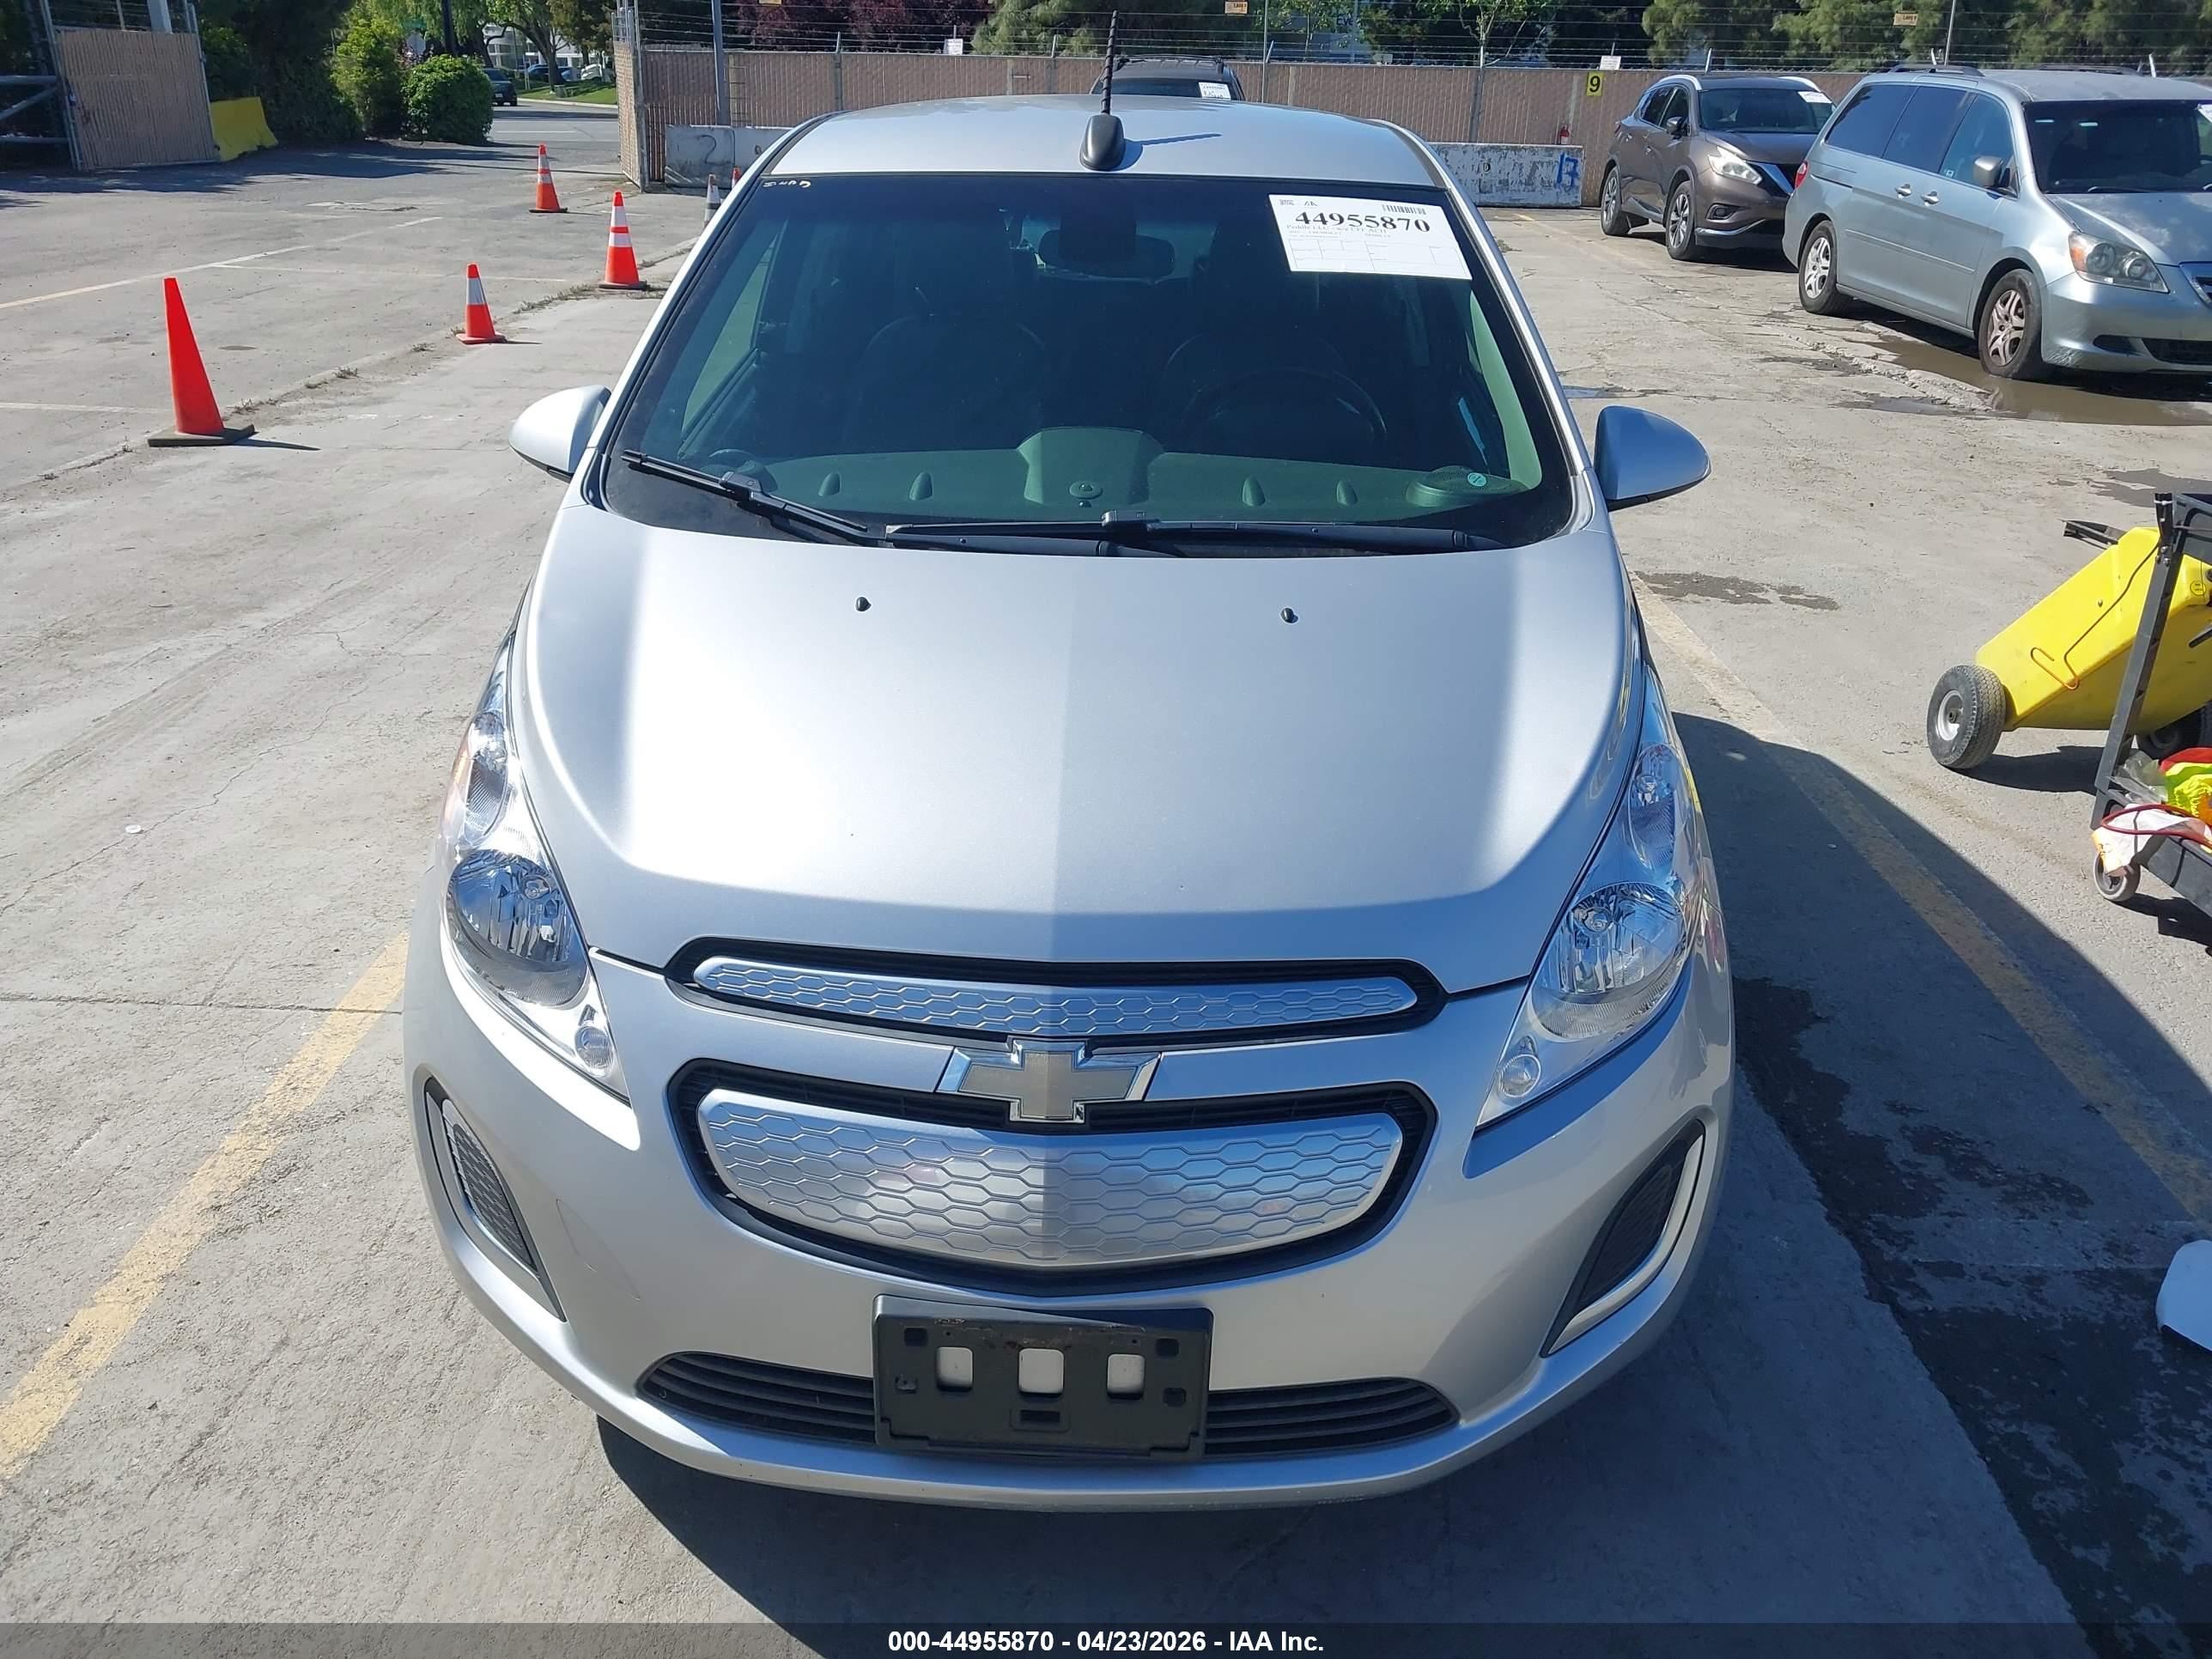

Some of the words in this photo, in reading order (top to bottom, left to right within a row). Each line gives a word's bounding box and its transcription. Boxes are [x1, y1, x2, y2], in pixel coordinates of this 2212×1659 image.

[1589, 76, 1601, 93] 9
[694, 134, 732, 165] 2
[1295, 211, 1430, 233] 44955870
